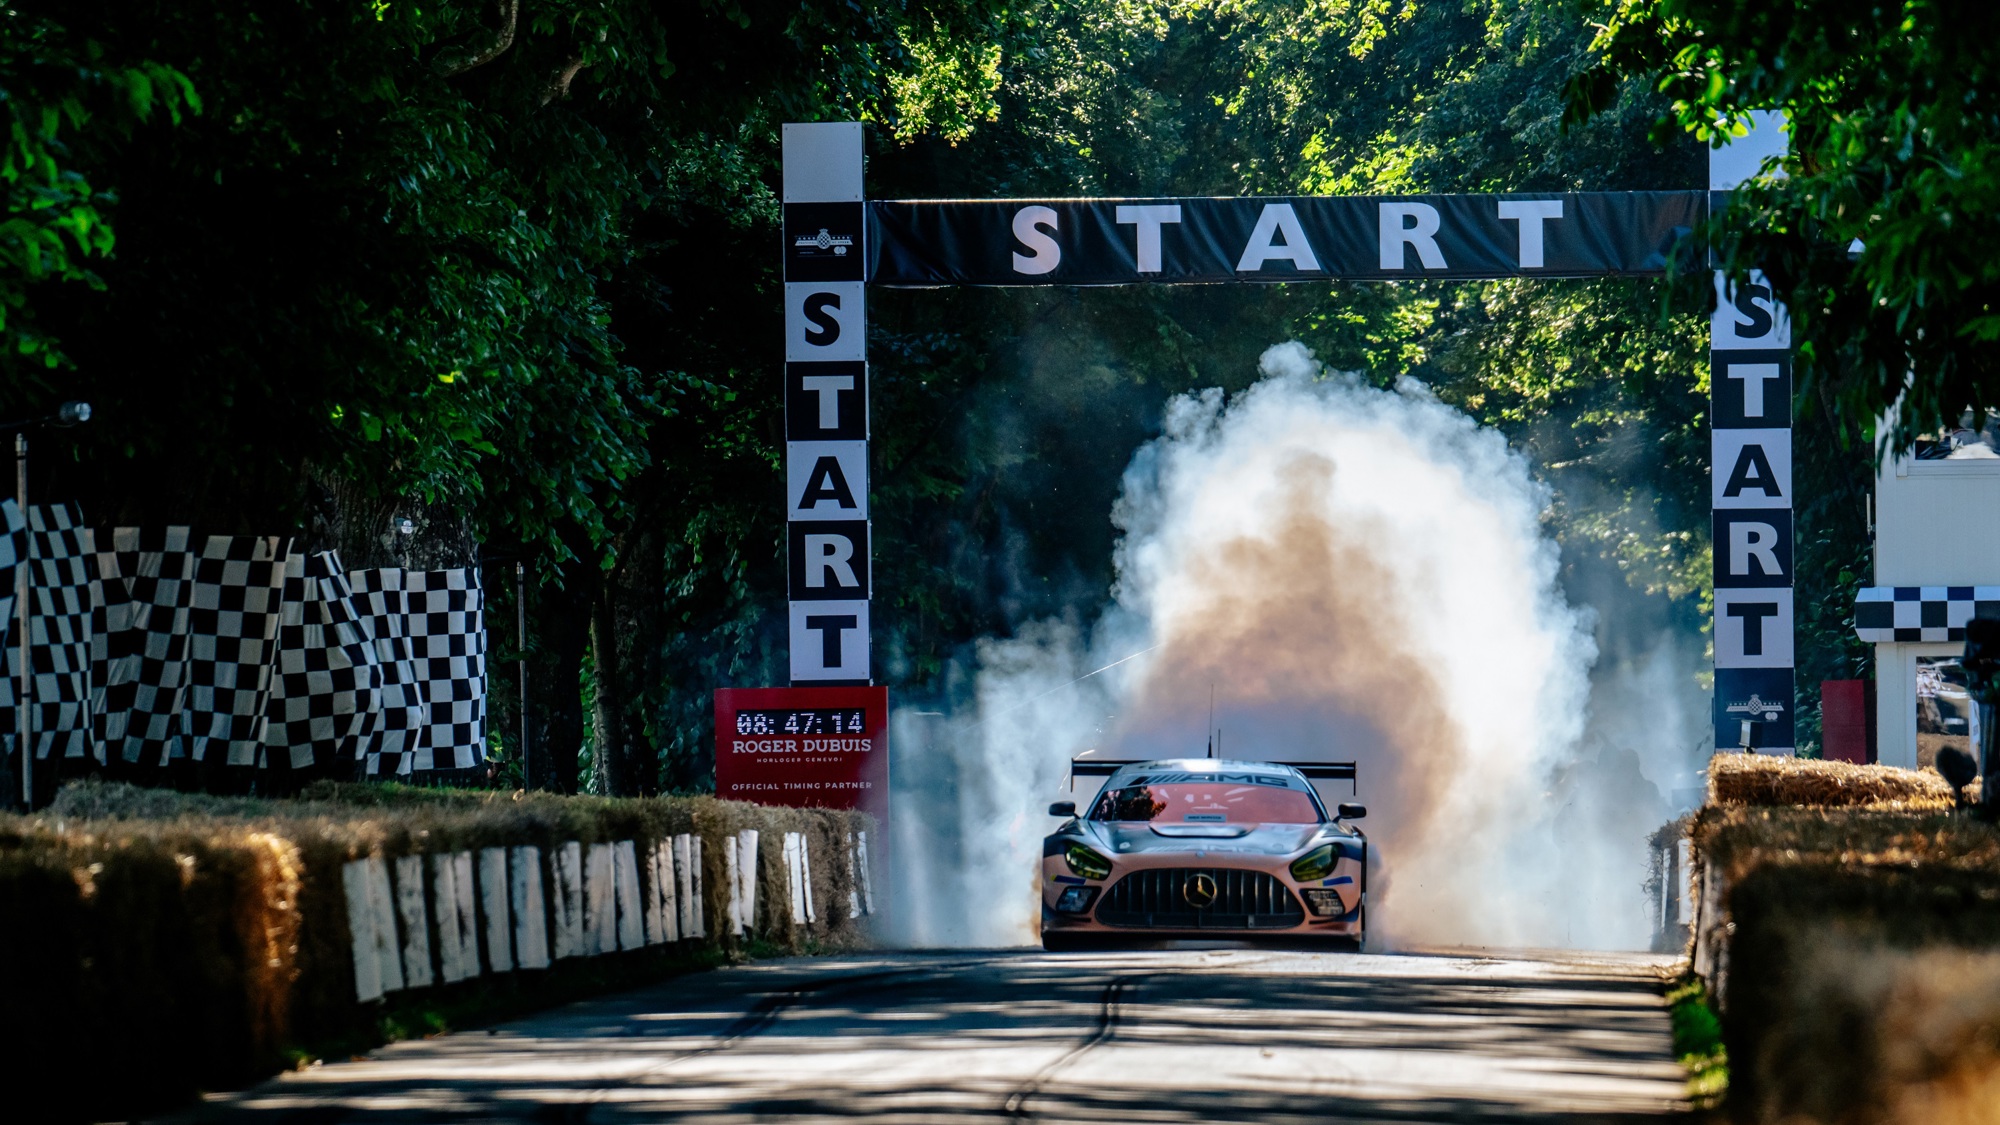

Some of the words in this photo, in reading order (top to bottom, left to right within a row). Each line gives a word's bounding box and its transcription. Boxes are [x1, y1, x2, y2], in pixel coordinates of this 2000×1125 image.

[1012, 200, 1564, 275] START
[798, 292, 860, 668] START
[1722, 283, 1783, 656] START
[732, 740, 798, 754] ROGER
[802, 739, 872, 753] DUBUIS
[731, 783, 780, 791] OFFICIAL
[784, 782, 821, 790] TIMING
[825, 781, 872, 790] PARTNER
[1180, 773, 1289, 788] AMG
